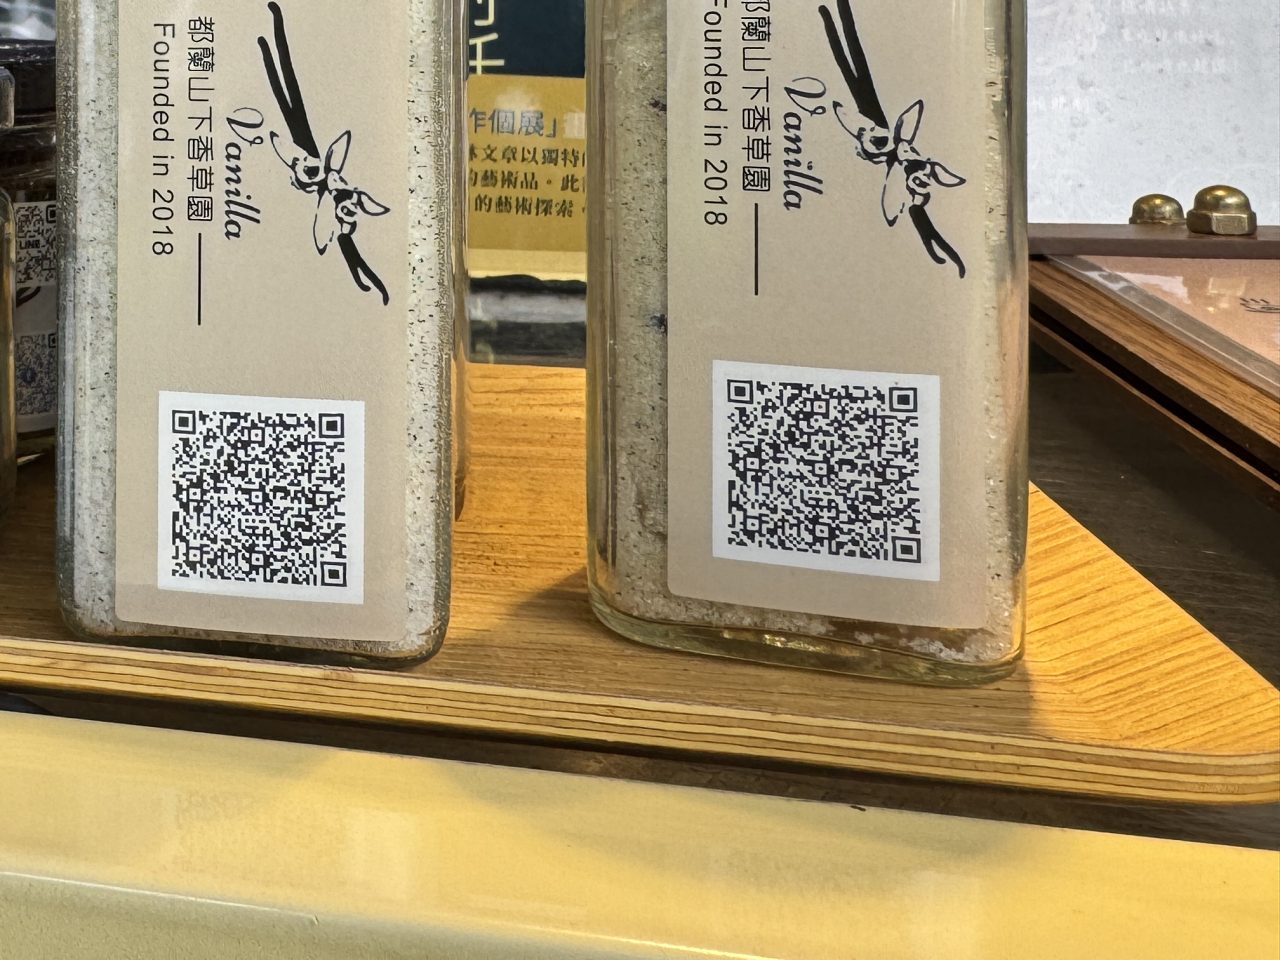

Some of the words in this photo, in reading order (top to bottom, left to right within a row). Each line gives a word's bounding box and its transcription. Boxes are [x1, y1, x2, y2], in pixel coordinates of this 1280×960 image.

[152, 23, 175, 142] Founded
[187, 16, 215, 222] 都蘭山下香草園
[152, 154, 175, 177] in
[224, 107, 264, 241] Vanilla
[703, 124, 728, 147] in
[783, 76, 827, 211] Vanilla
[152, 189, 174, 256] 2018
[703, 159, 728, 226] 2018
